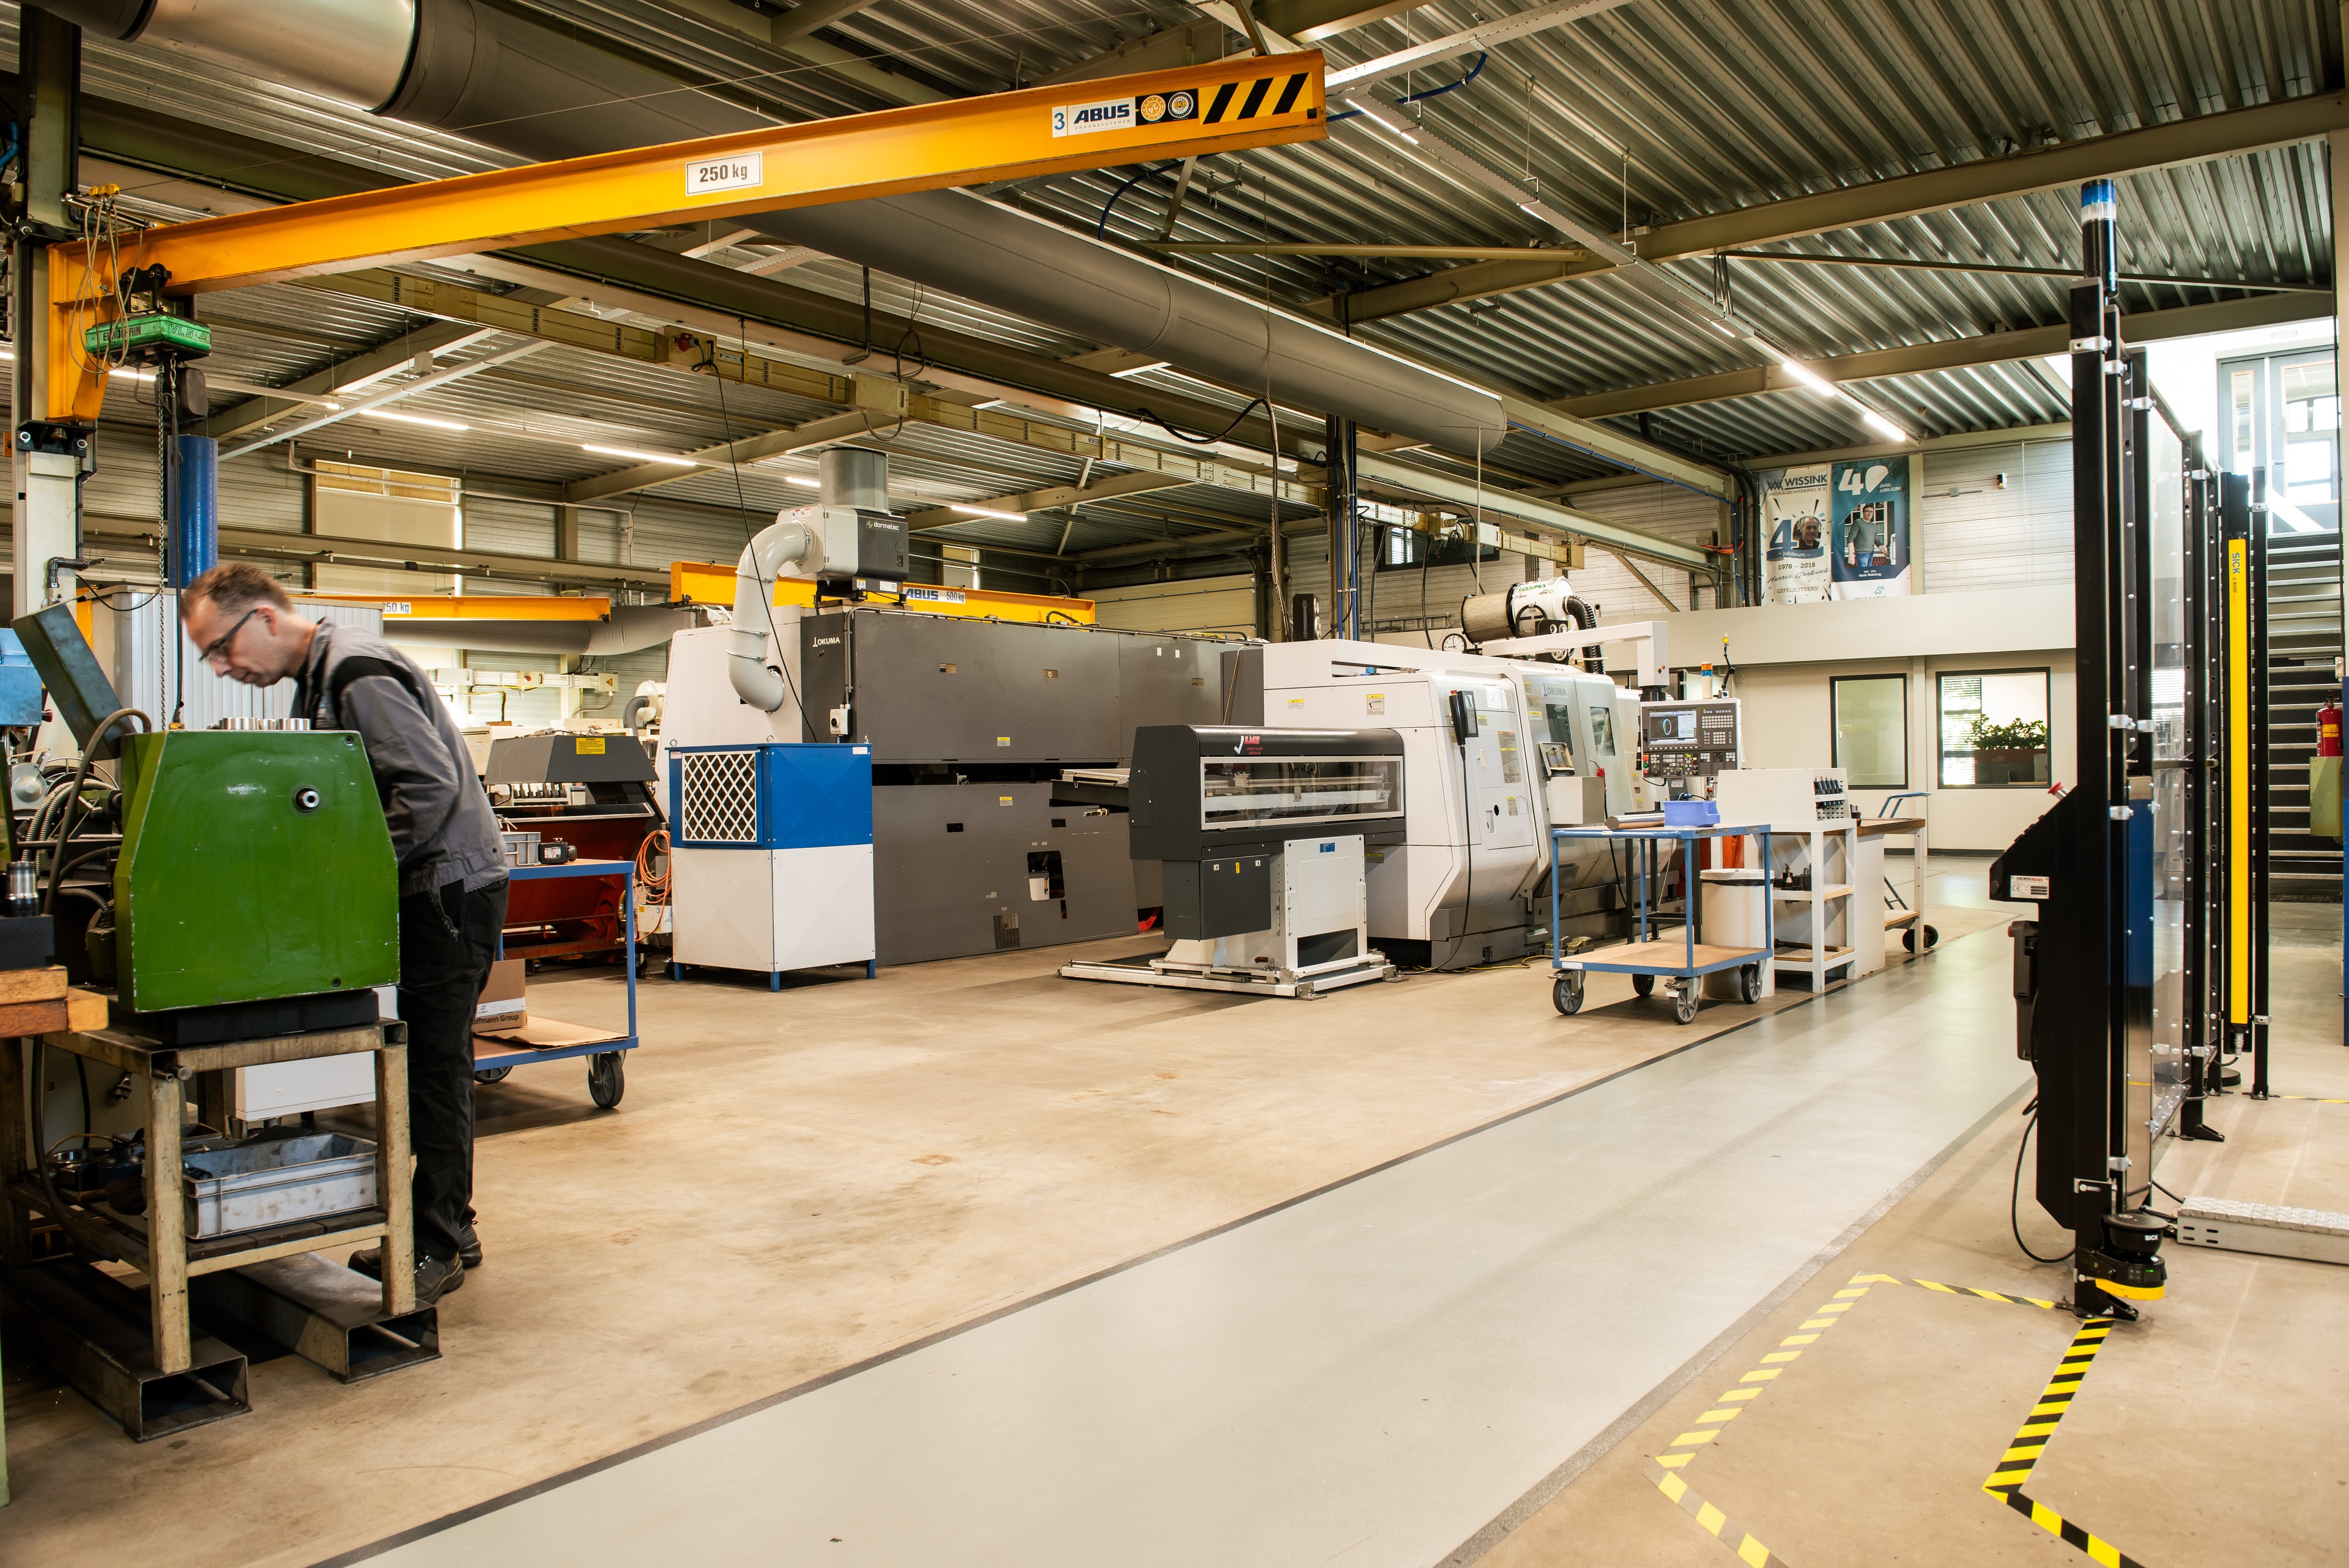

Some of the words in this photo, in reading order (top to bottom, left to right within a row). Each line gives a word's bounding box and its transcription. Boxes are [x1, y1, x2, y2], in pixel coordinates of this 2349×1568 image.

[1054, 112, 1064, 130] 3
[1073, 103, 1130, 124] ABUS
[1075, 119, 1131, 130] KRAANSYSTEMEN
[700, 165, 729, 182] 250
[732, 163, 748, 180] kg
[1784, 474, 1828, 487] WISSINK
[1838, 465, 1889, 496] 40
[1768, 488, 1817, 496] METAALBEWERKING
[874, 521, 900, 530] dormatec
[2232, 552, 2241, 574] SICK
[906, 588, 938, 600] ABUS
[946, 591, 957, 601] 500
[958, 593, 965, 603] kg
[400, 602, 409, 614] kg
[817, 636, 841, 645] OKUMA
[1546, 686, 1567, 696] OKUMA
[472, 1016, 499, 1025] offmann
